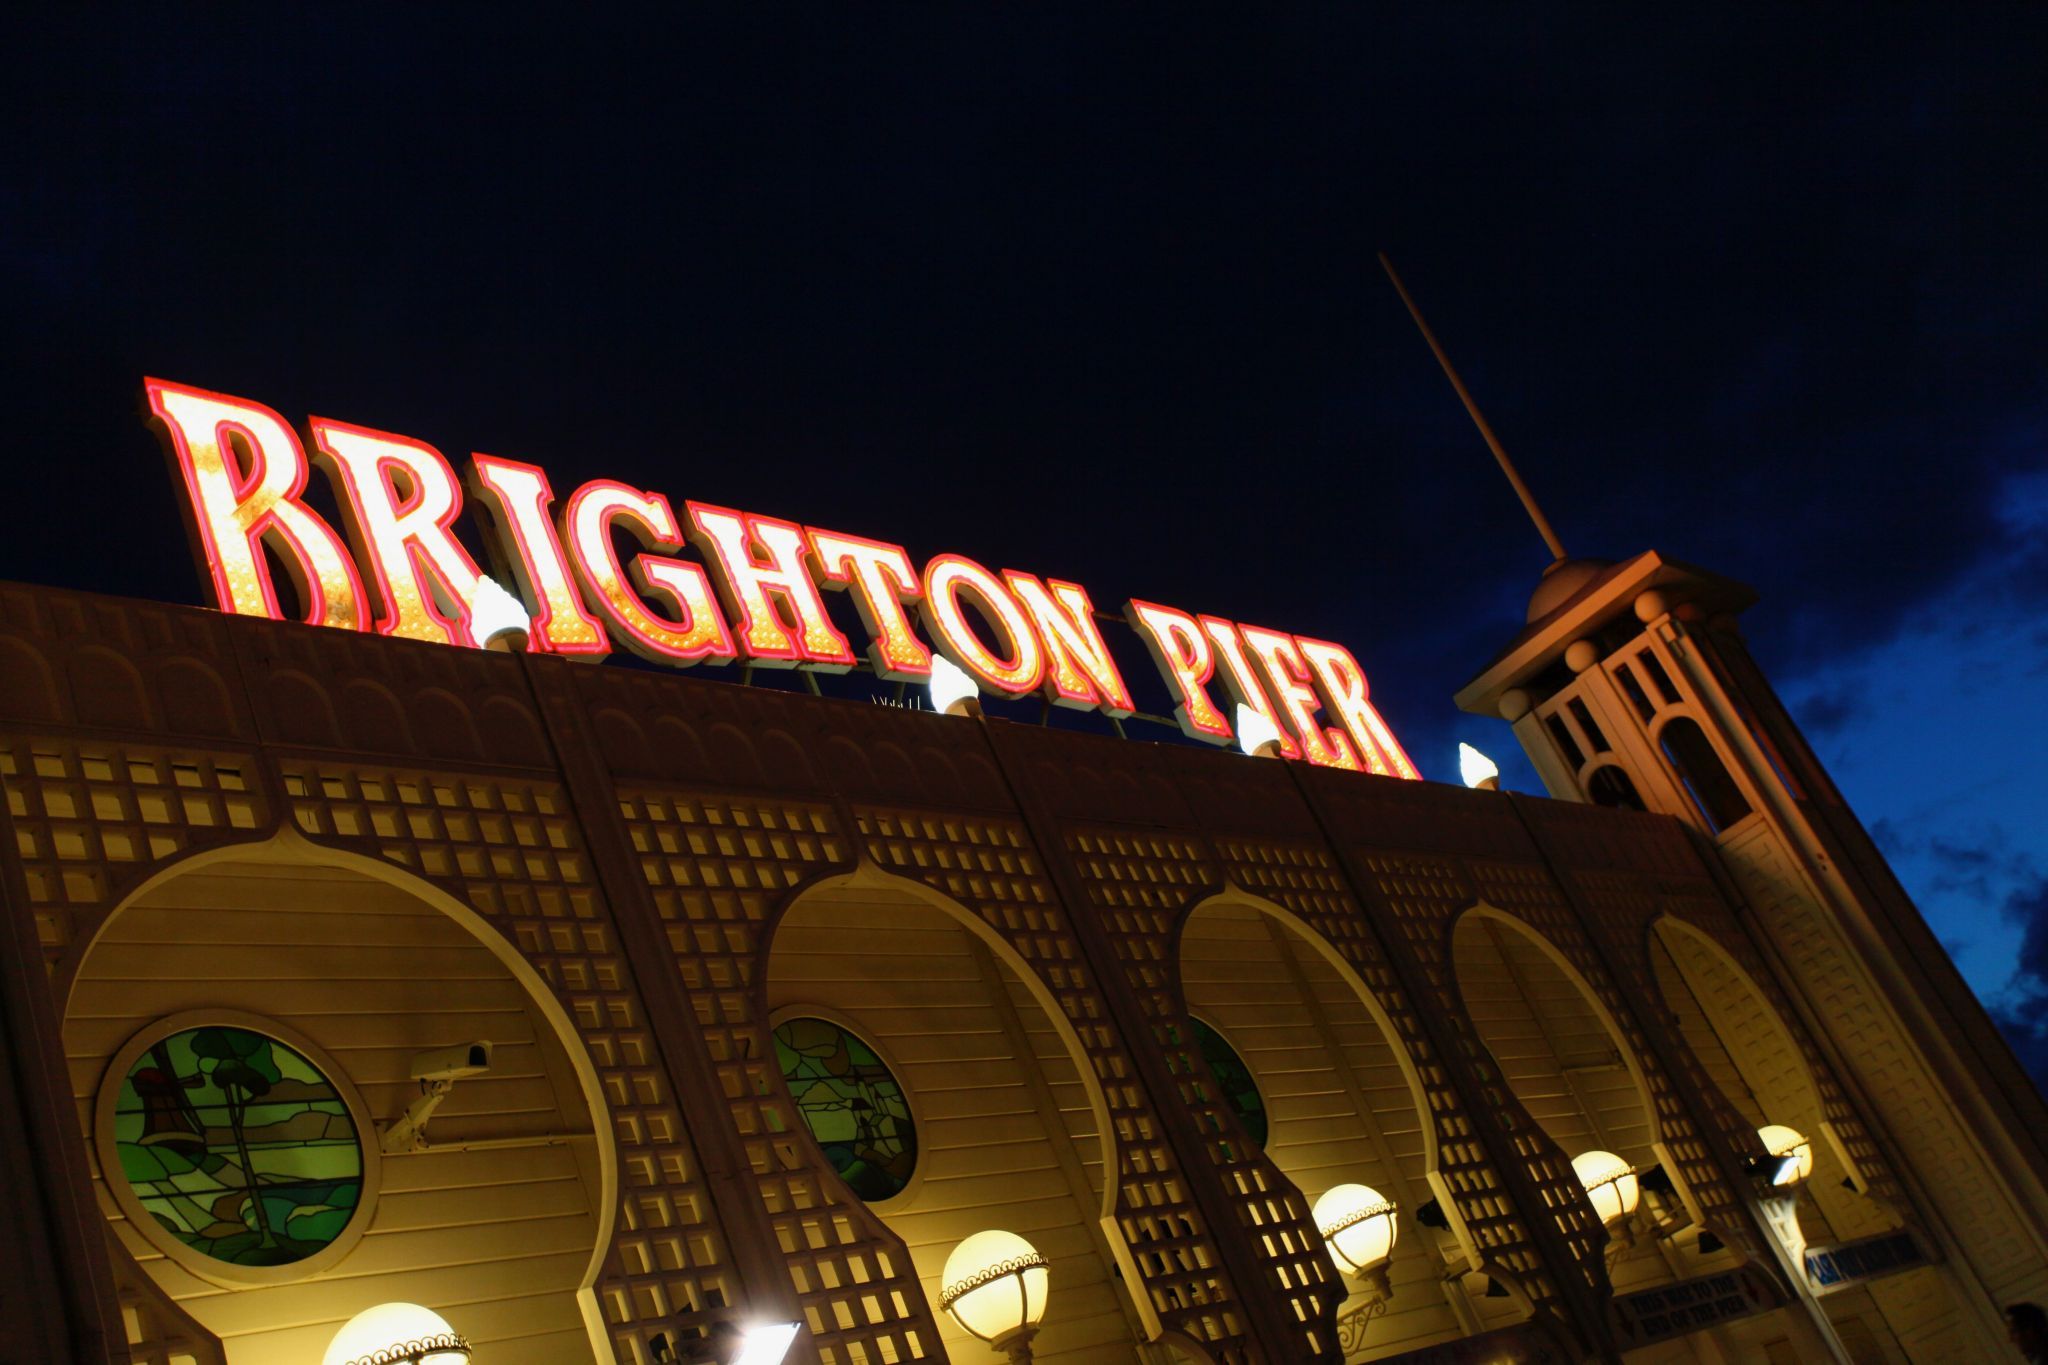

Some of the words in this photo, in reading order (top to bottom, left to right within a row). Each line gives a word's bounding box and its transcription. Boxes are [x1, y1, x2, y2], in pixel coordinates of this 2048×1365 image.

[143, 376, 1136, 716] BRIGHTON
[1128, 598, 1423, 781] PIER
[1630, 1293, 1666, 1315] THIS
[1692, 1279, 1712, 1299] TO
[1709, 1274, 1738, 1294] THE
[1669, 1309, 1691, 1329] OF
[1688, 1302, 1718, 1325] THE
[1714, 1294, 1749, 1317] PIER
